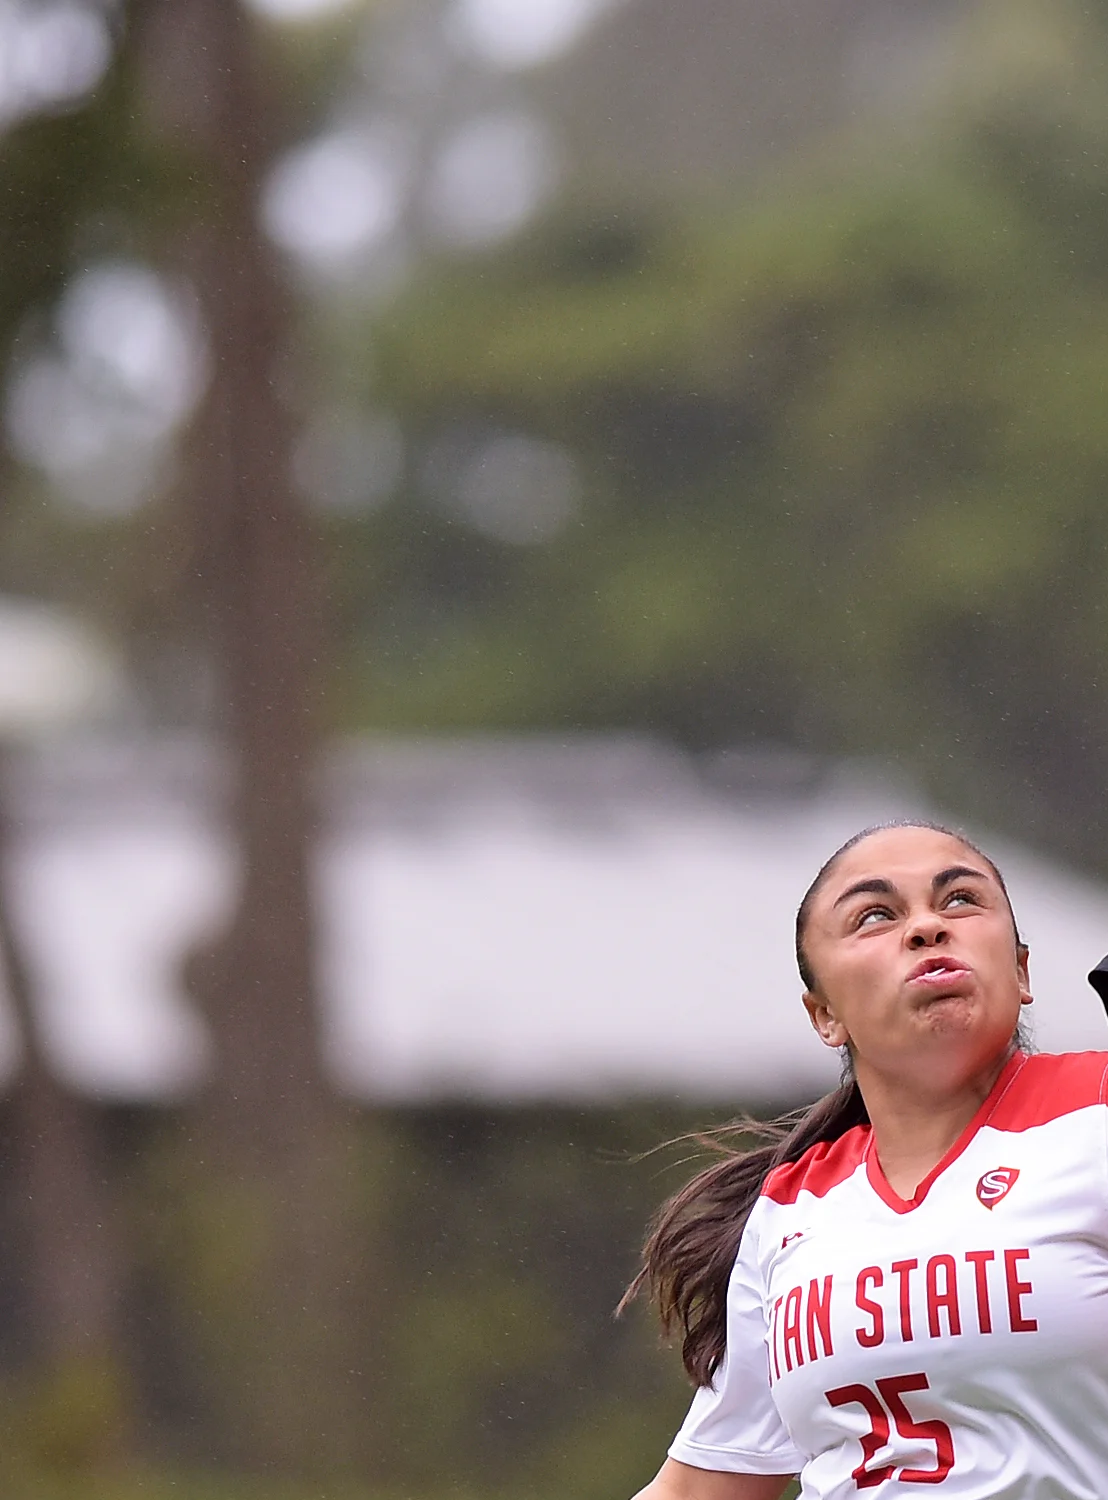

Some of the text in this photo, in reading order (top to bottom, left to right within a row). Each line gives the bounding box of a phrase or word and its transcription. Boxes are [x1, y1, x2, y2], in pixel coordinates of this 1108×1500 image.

[768, 1248, 1038, 1388] TAN STATE
[824, 1372, 955, 1490] 25
